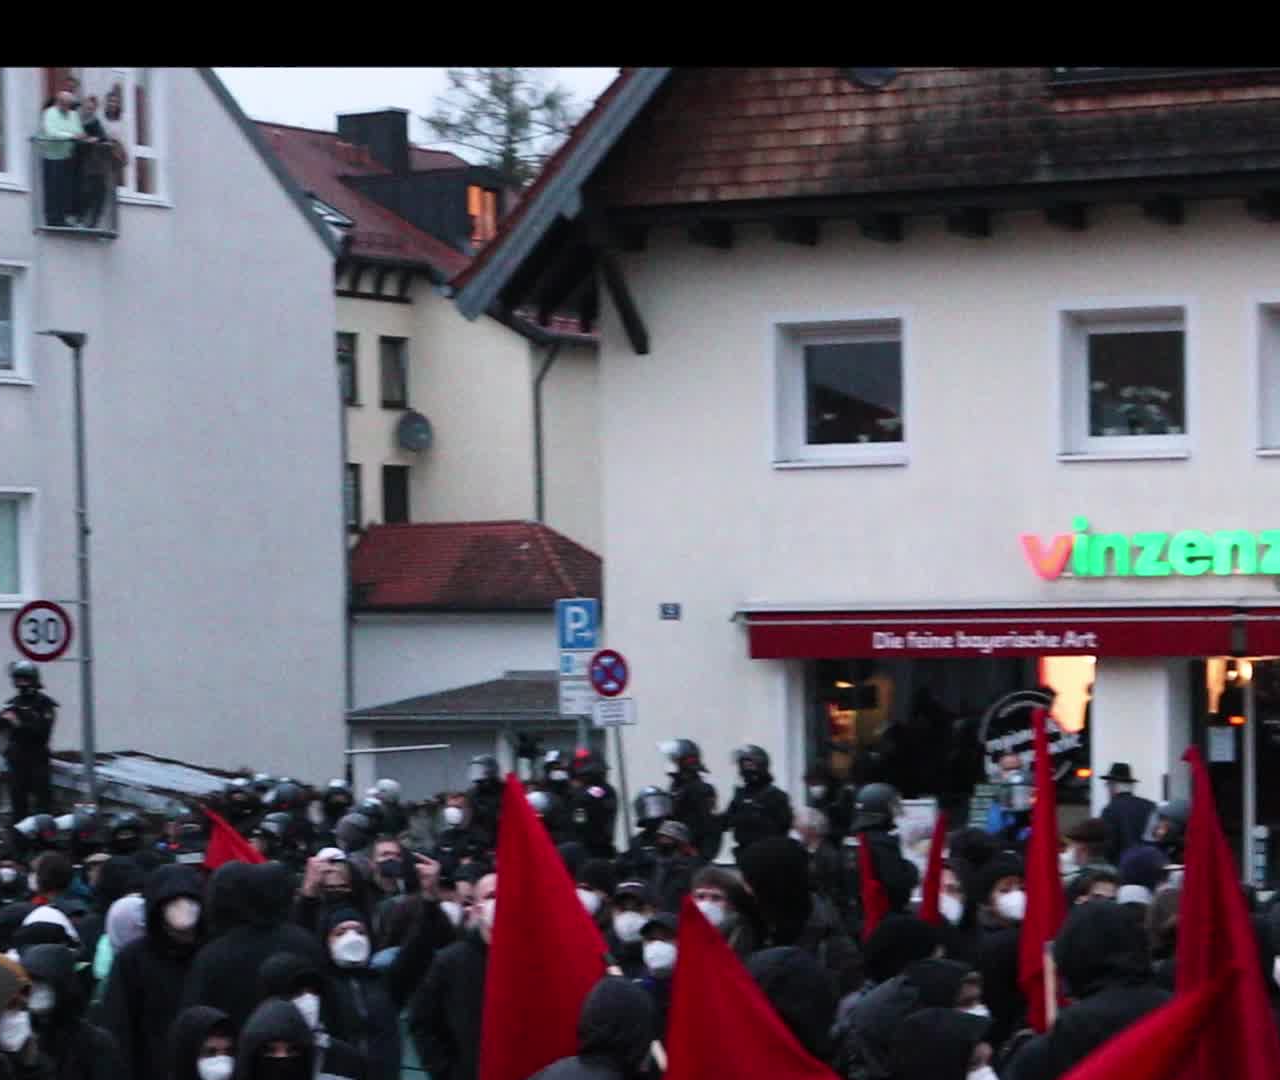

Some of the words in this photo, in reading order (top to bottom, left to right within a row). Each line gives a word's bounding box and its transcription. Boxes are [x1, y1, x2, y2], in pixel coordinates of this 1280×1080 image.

[22, 617, 60, 645] 30
[565, 605, 590, 642] P
[872, 631, 904, 650] Die
[907, 630, 954, 649] feine
[956, 630, 1061, 654] bayerische
[1062, 630, 1098, 648] Art
